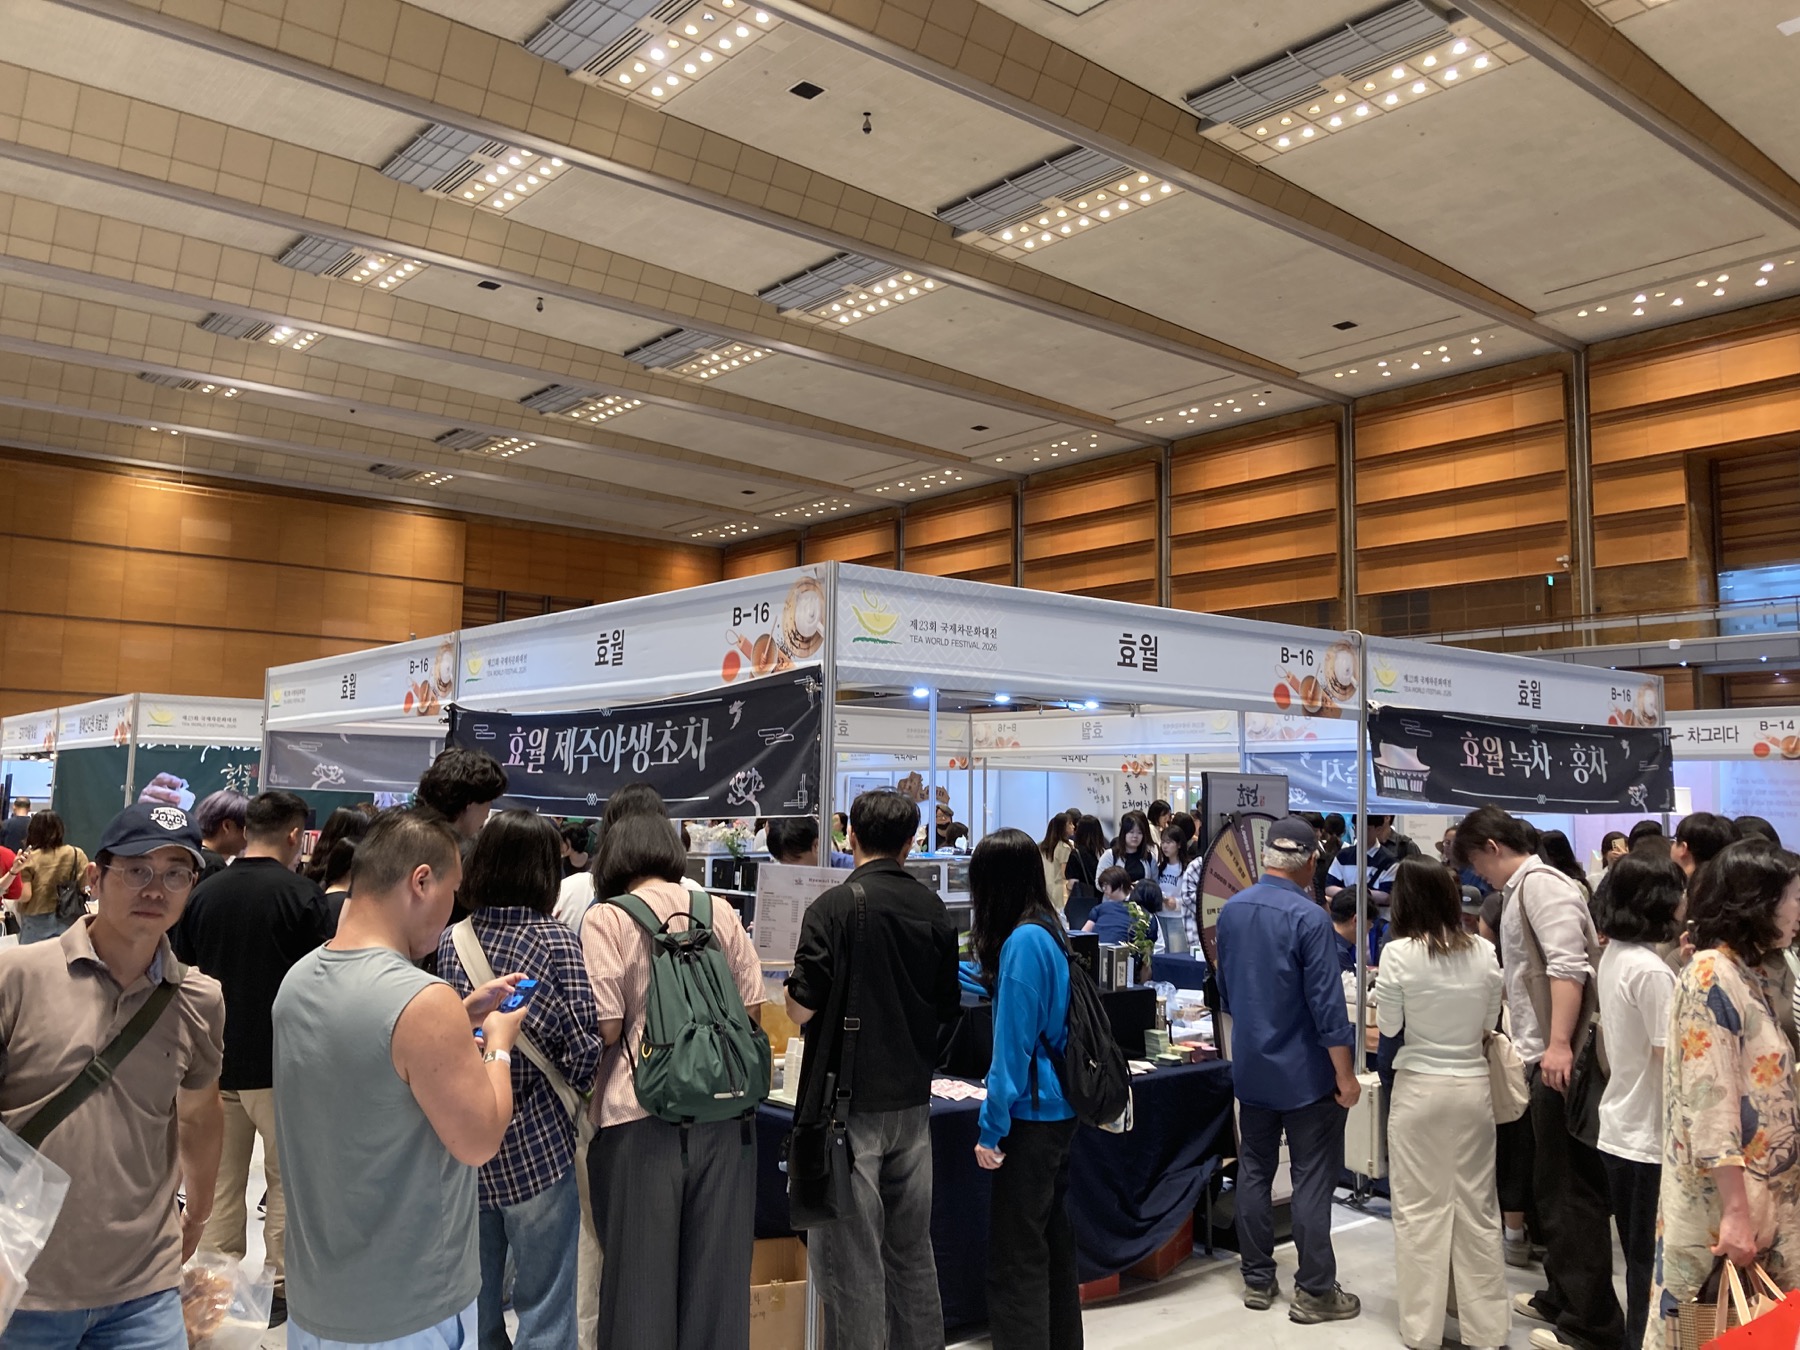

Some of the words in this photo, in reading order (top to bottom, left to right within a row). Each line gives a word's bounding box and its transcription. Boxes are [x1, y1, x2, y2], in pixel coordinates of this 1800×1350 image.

[732, 602, 770, 627] B-16
[909, 619, 937, 633] 제23회
[940, 622, 998, 639] 국제차문화대전
[595, 629, 625, 667] 효월
[909, 634, 924, 643] TEA
[925, 636, 949, 646] WORLD
[951, 639, 980, 650] FESTIVAL
[981, 642, 998, 652] 2026
[1117, 633, 1158, 672] 효월
[409, 658, 429, 675] B-16
[1280, 646, 1314, 667] B-16
[341, 673, 357, 700] 효월
[1517, 680, 1541, 709] 효월
[1610, 687, 1632, 703] B-16
[1687, 725, 1739, 744] 차그리다
[1760, 720, 1795, 731] B-14
[502, 725, 549, 774] 효월
[1460, 731, 1505, 777] 효월
[1510, 738, 1553, 780] 녹차
[1569, 742, 1609, 785] 홍차
